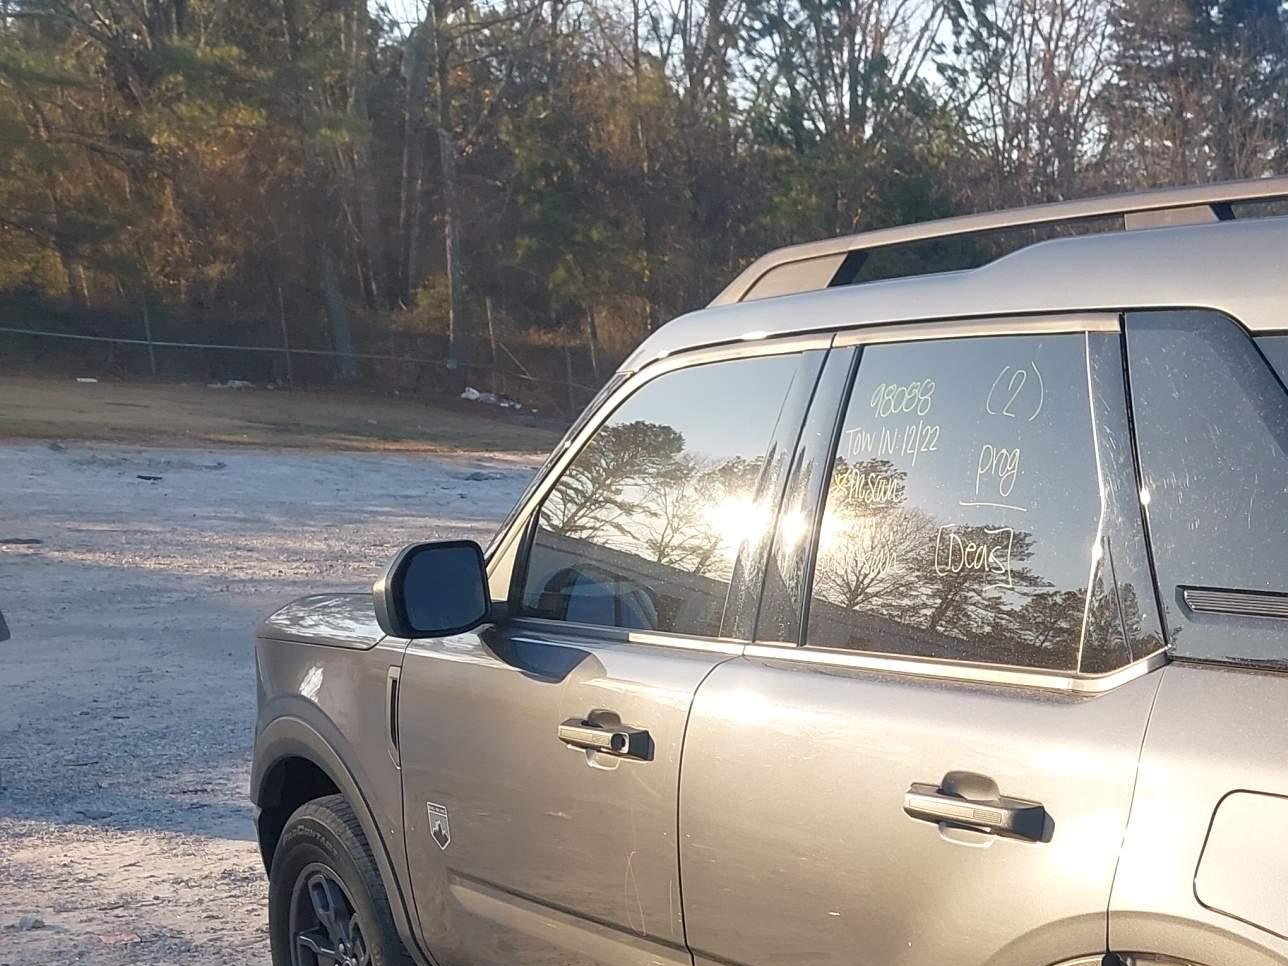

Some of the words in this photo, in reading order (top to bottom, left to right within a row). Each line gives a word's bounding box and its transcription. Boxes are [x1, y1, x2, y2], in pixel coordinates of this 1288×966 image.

[985, 361, 1044, 421] (2)
[846, 428, 875, 458] TOW
[901, 420, 940, 467] 12/22
